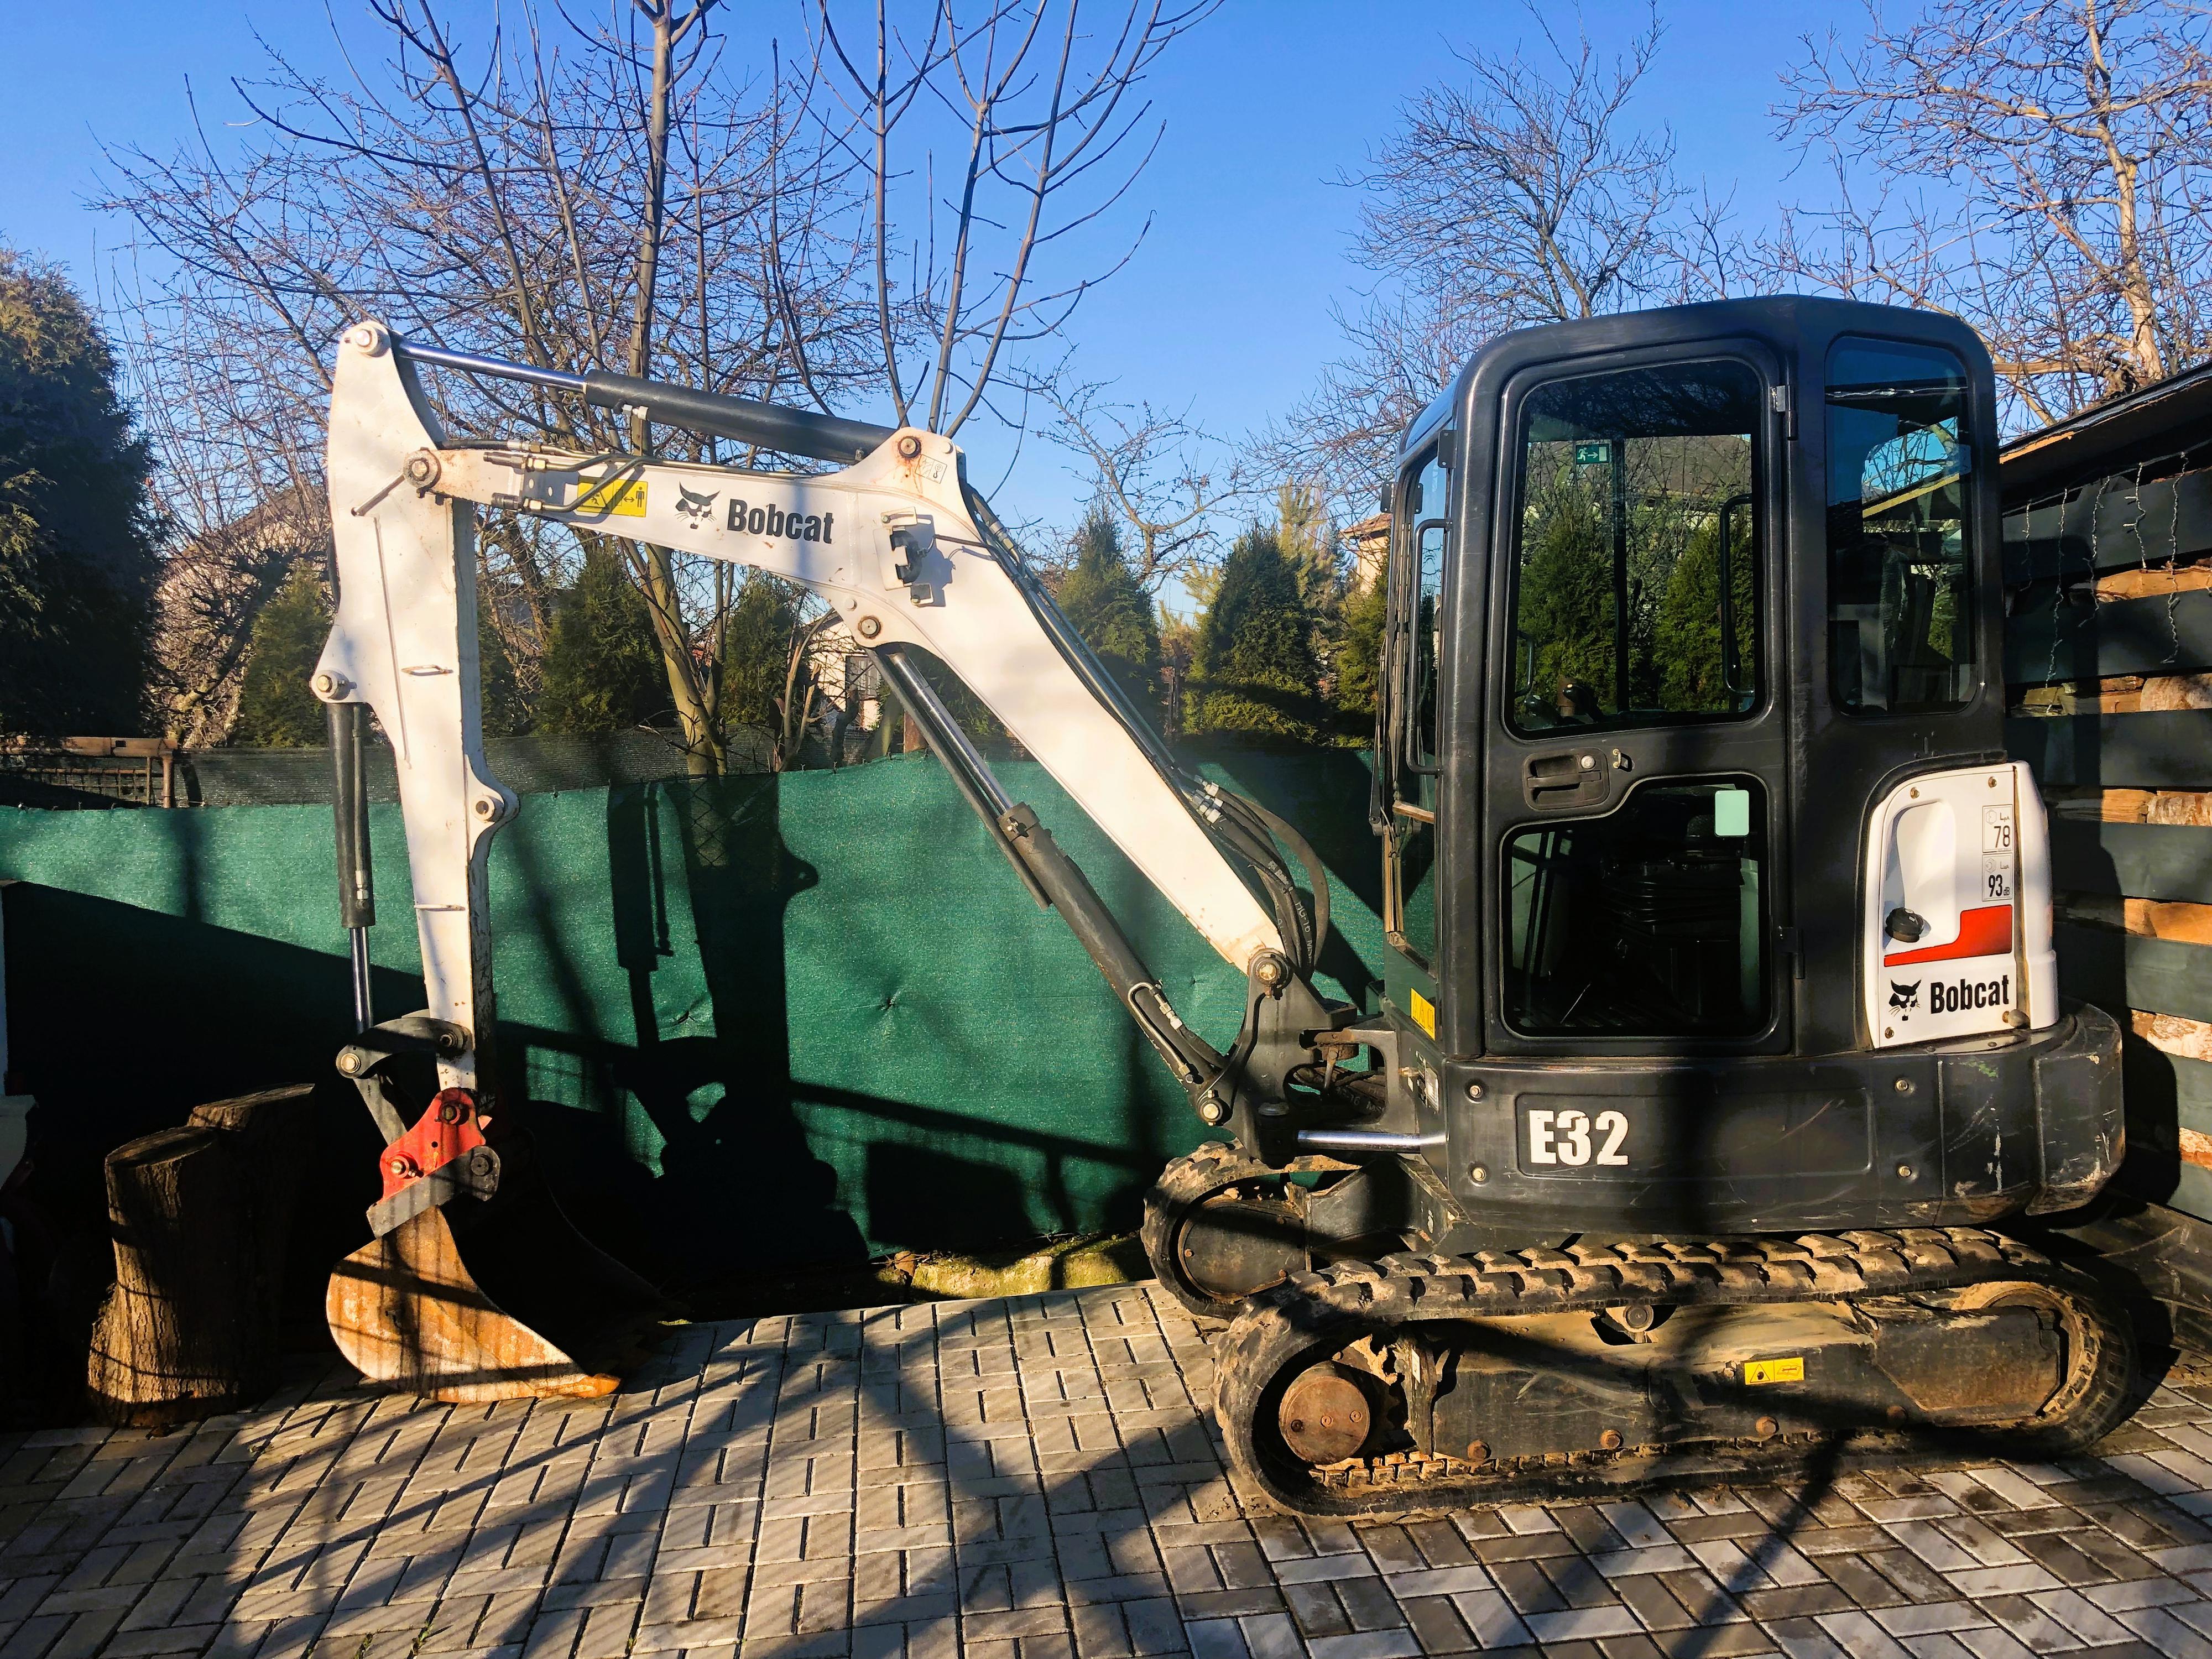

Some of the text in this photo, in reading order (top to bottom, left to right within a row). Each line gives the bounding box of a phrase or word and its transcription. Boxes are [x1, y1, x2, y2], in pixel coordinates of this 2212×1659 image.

[727, 498, 834, 544] Bobcat
[1994, 825, 2010, 848] 78
[1989, 874, 2003, 898] 93
[1931, 974, 2010, 1014] Bobcat
[1528, 1110, 1629, 1166] E32
